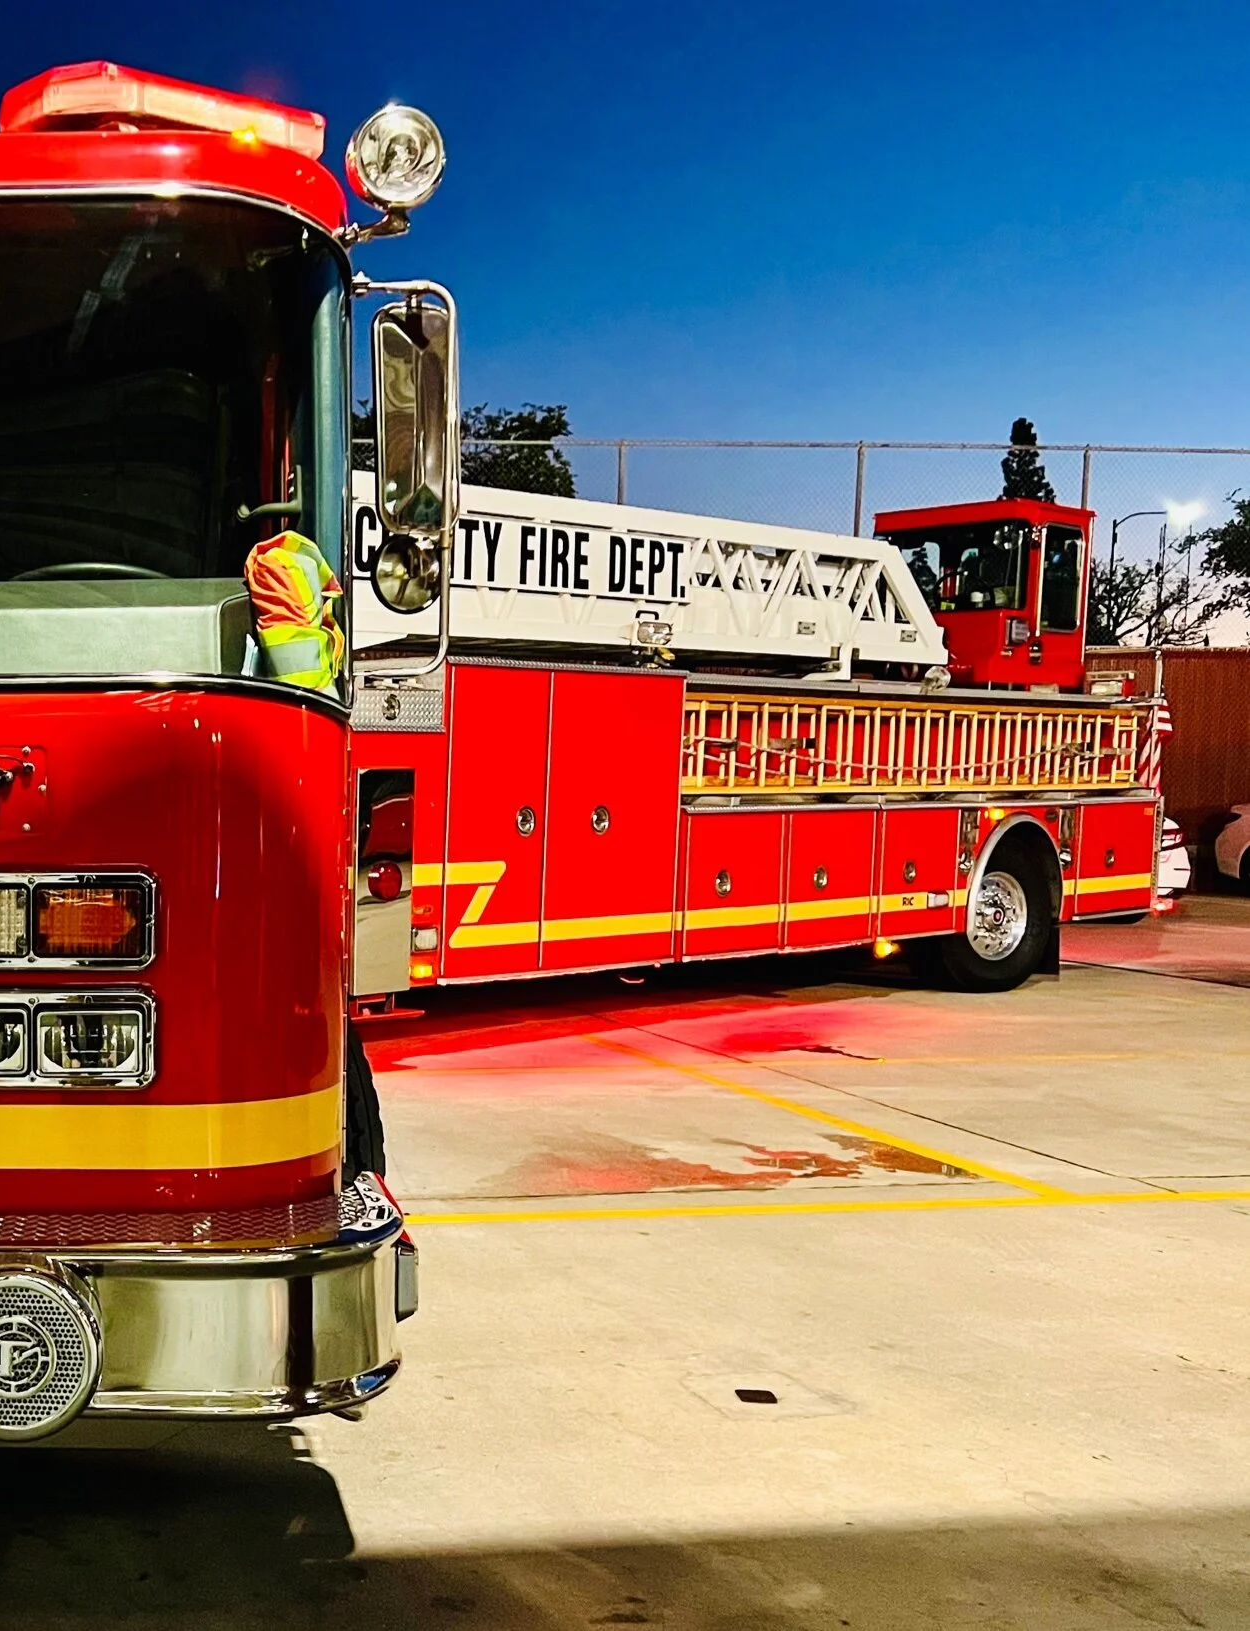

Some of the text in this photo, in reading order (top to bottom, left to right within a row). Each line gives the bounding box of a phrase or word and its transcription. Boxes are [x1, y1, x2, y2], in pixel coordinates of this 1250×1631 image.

[354, 506, 686, 598] CTY FIRE DEPT.
